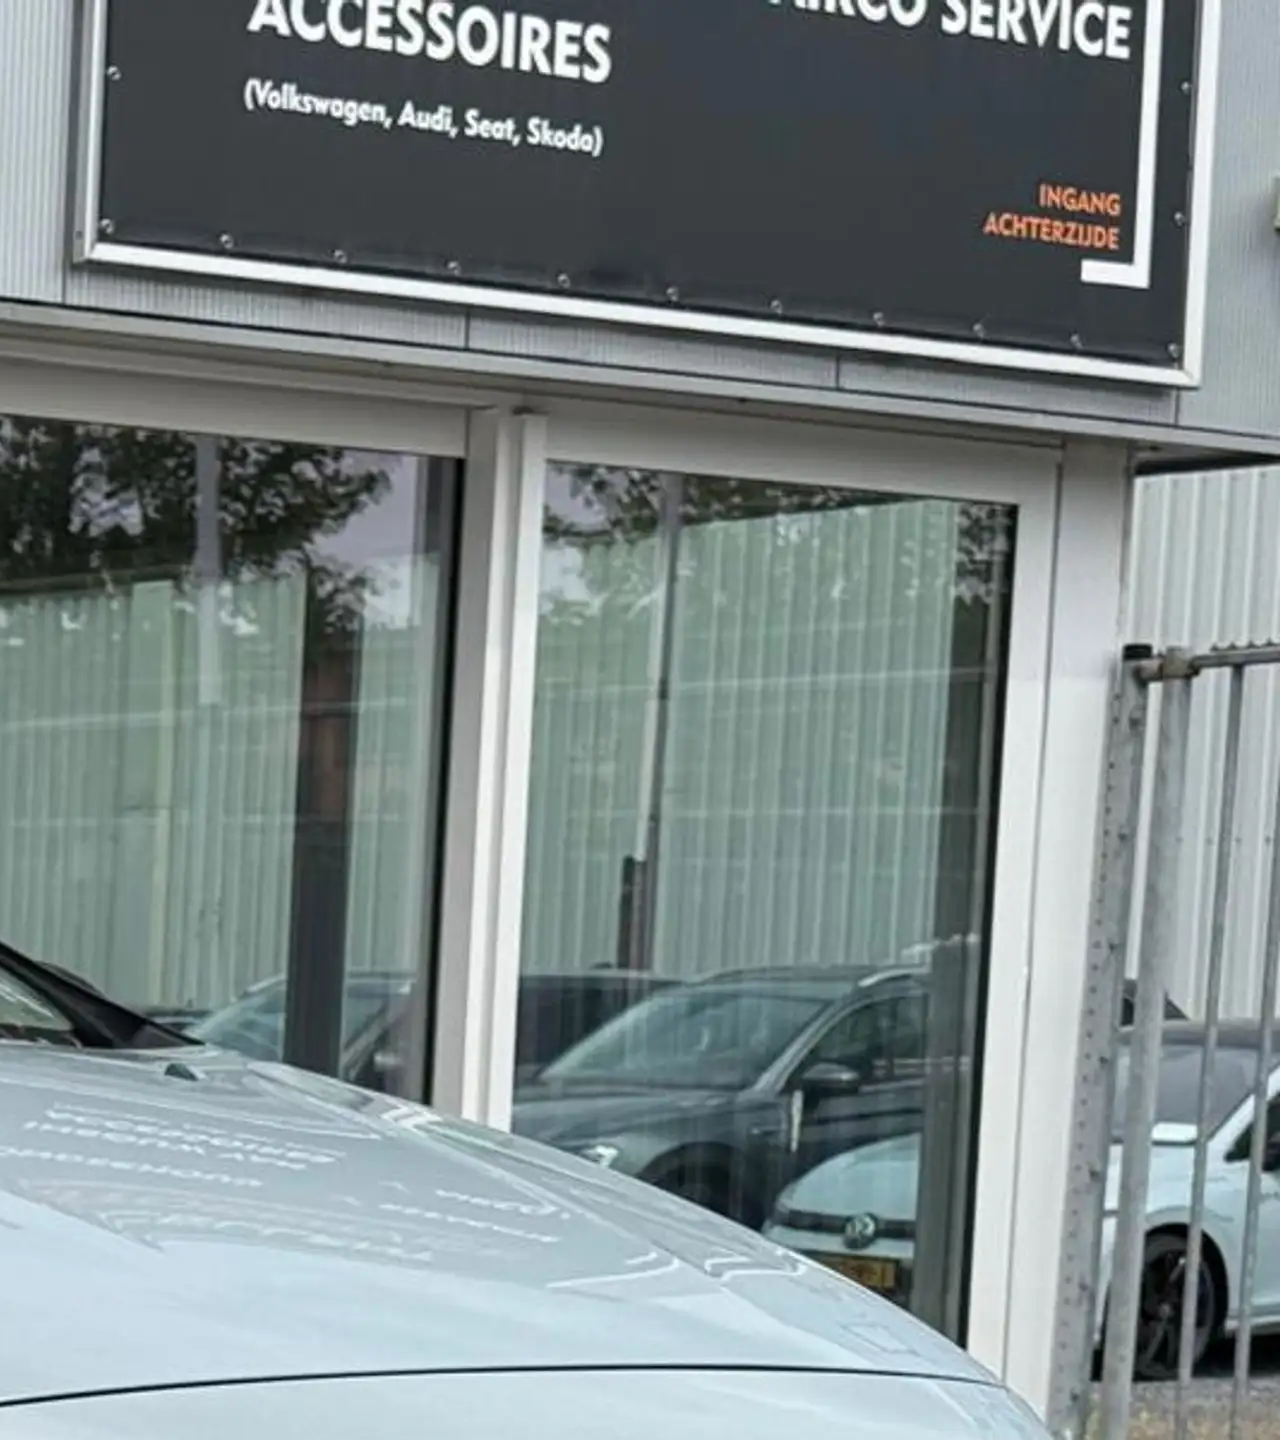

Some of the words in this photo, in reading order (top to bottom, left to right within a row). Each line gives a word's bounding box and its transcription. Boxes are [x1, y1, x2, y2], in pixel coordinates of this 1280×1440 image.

[247, 0, 612, 84] ACCESSOIRES
[940, 0, 1132, 60] SERVICE
[243, 77, 393, 130] (Volkswagen,
[397, 100, 458, 139] Audi,
[464, 108, 521, 148] Seat,
[526, 116, 604, 158] Skoda)
[1038, 182, 1122, 217] INGANG
[982, 212, 1120, 251] ACHTERZIJDE
